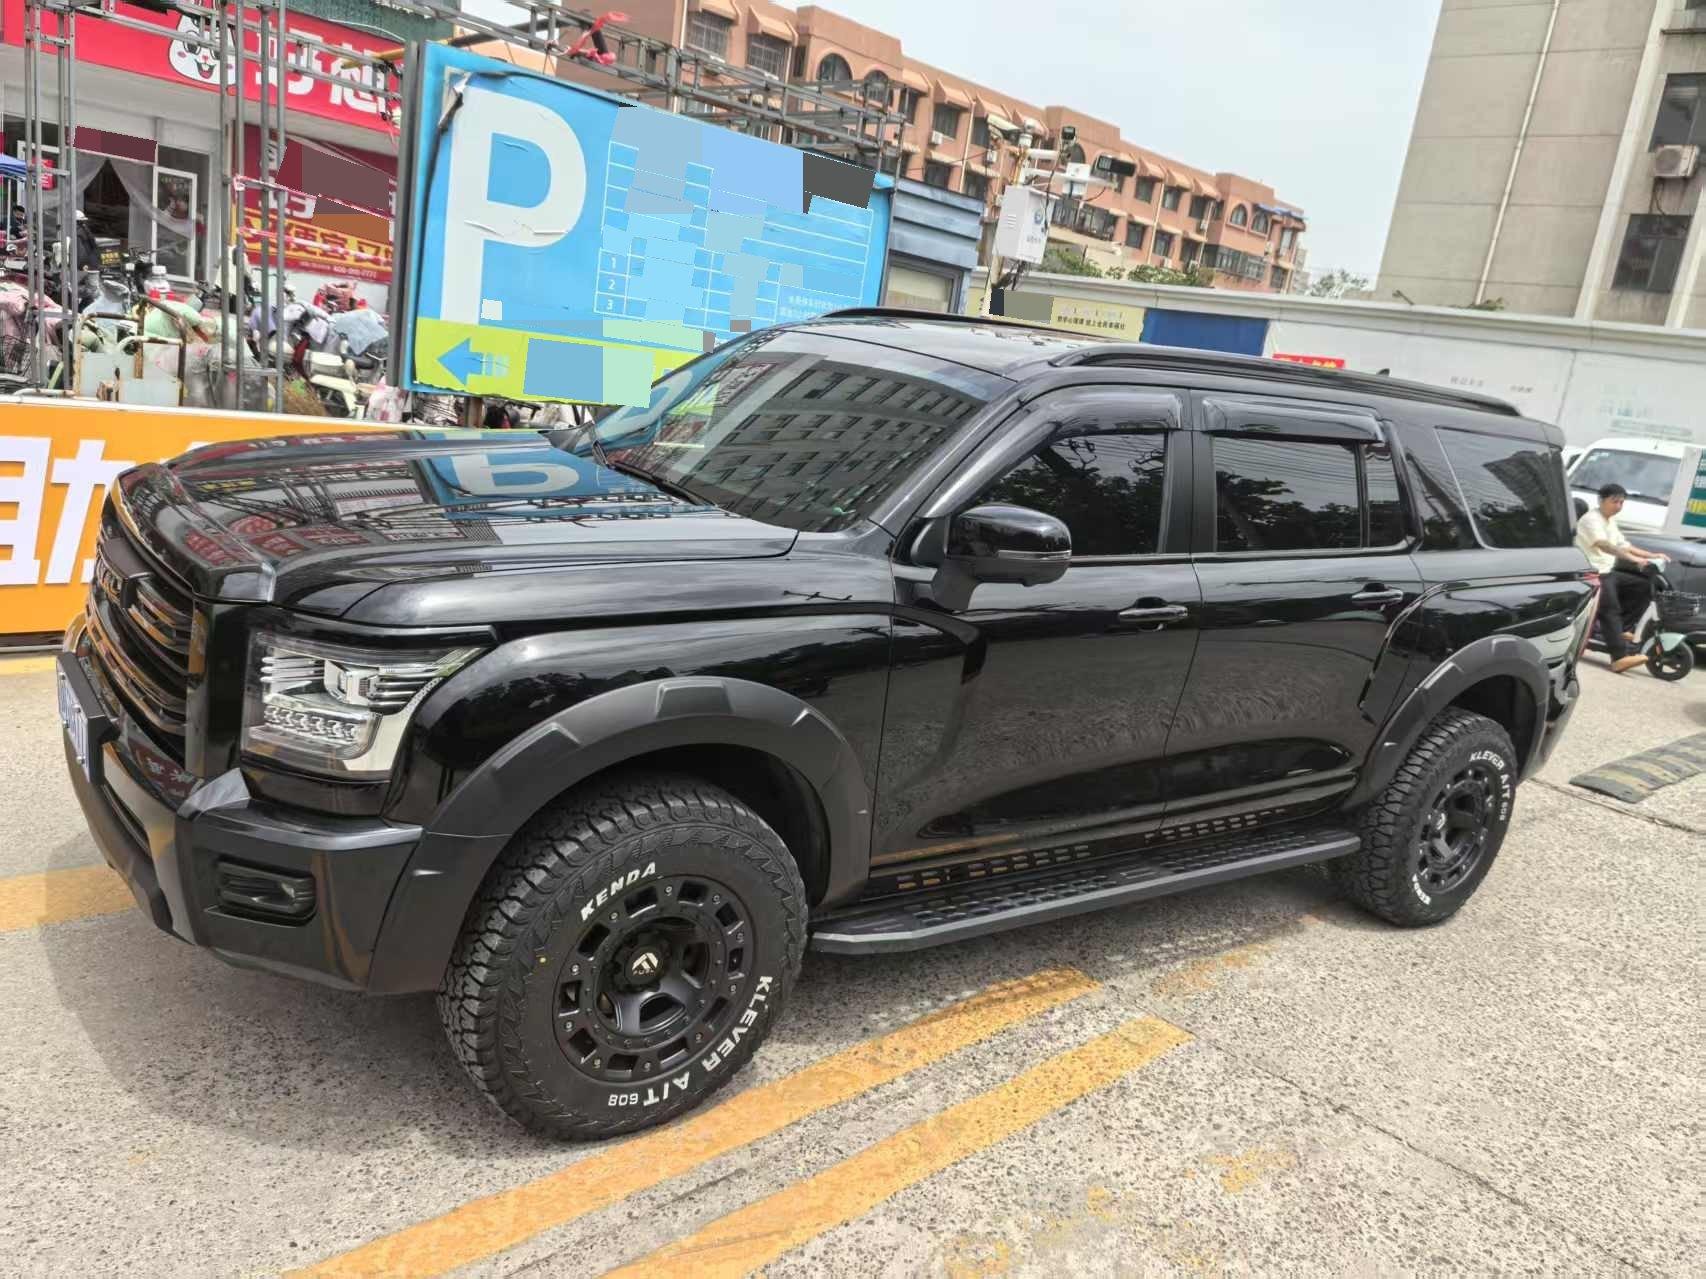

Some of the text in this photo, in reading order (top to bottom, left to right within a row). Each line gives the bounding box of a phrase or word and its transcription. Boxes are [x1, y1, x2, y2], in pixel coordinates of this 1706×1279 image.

[439, 84, 588, 325] P
[611, 257, 617, 269] 1
[608, 279, 616, 290] 2
[607, 299, 613, 310] 3
[1469, 750, 1506, 771] KLEVER
[580, 861, 656, 922] KENDA
[701, 975, 773, 1073] KLEVER
[643, 1071, 690, 1106] A/T
